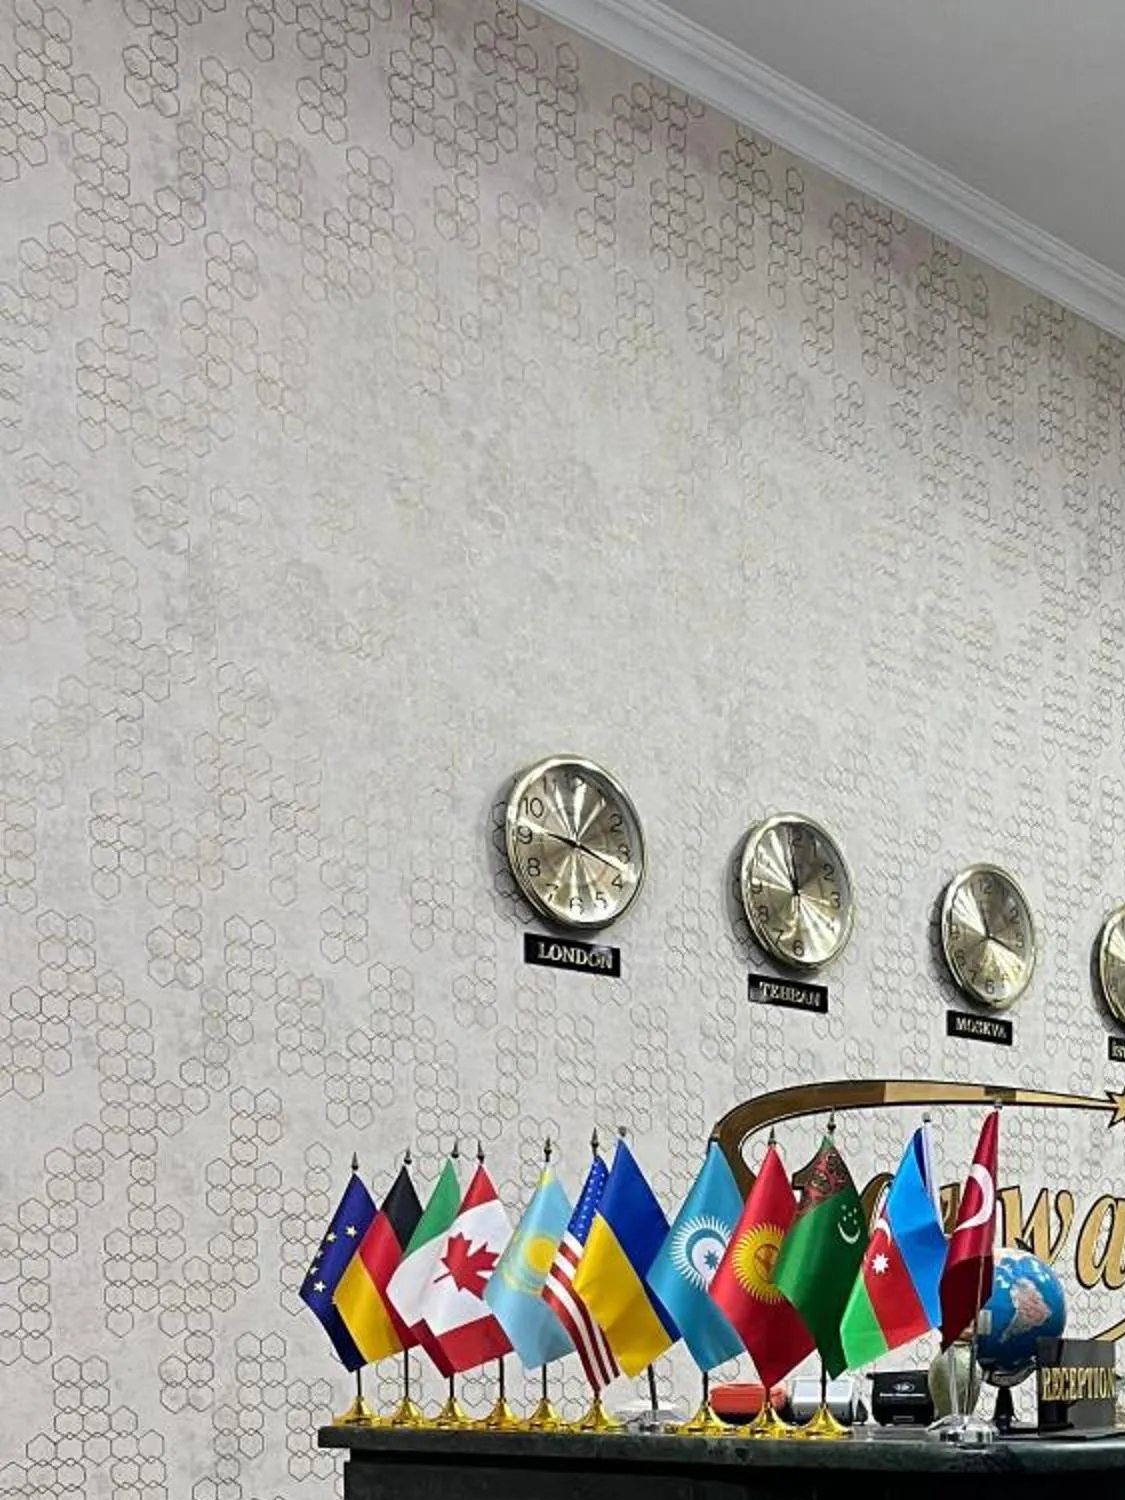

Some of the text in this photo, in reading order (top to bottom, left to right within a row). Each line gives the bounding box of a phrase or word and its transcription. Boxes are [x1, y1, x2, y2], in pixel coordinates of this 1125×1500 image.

[524, 797, 544, 818] 10
[609, 813, 623, 833] 2
[517, 826, 533, 844] 9
[527, 857, 541, 877] 8
[538, 942, 613, 969] LONDON
[1042, 1367, 1117, 1401] RECEPTION
